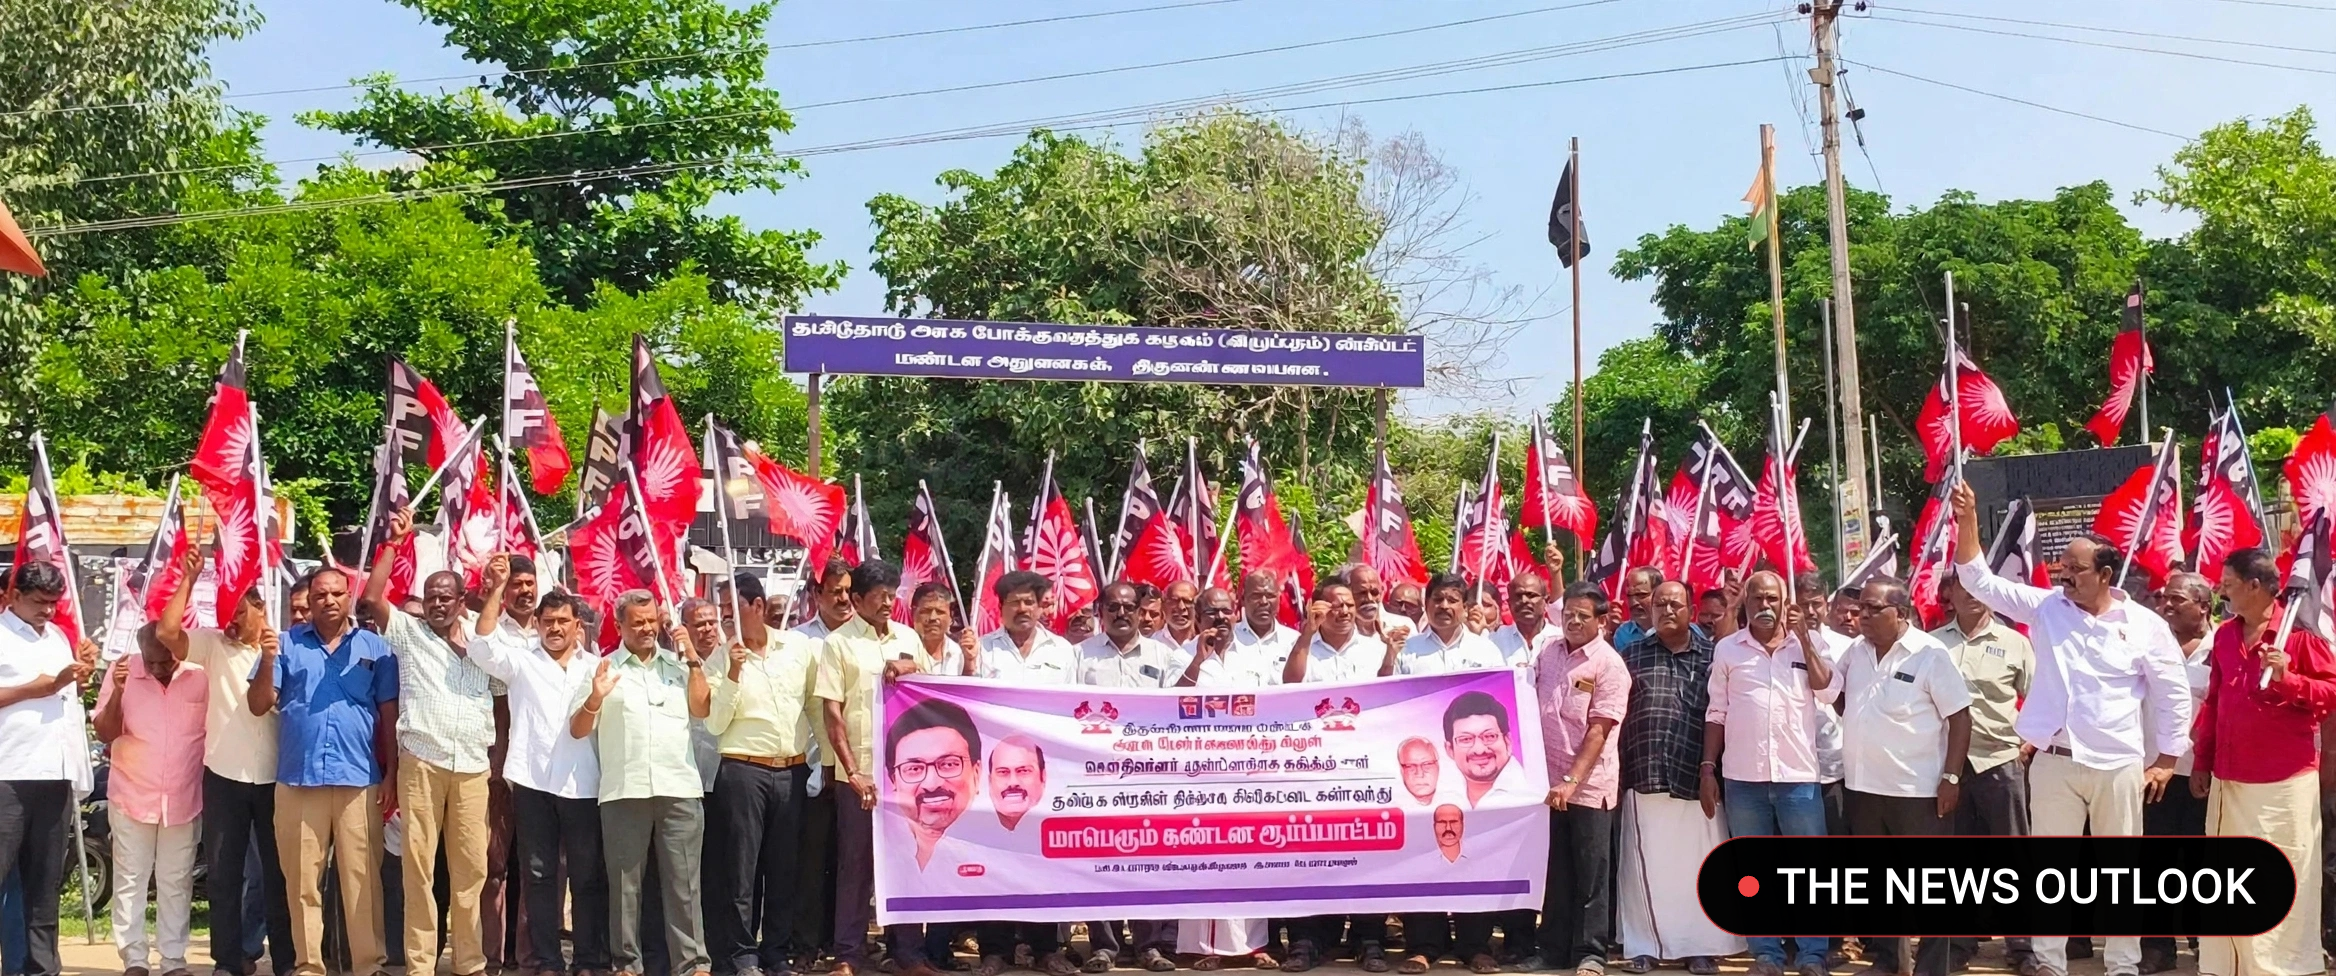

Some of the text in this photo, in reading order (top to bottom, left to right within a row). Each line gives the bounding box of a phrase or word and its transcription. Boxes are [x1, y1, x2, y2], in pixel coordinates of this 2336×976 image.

[1048, 811, 1397, 853] மாபெரும் கண்டன ஆர்ப்பாட்டம்
